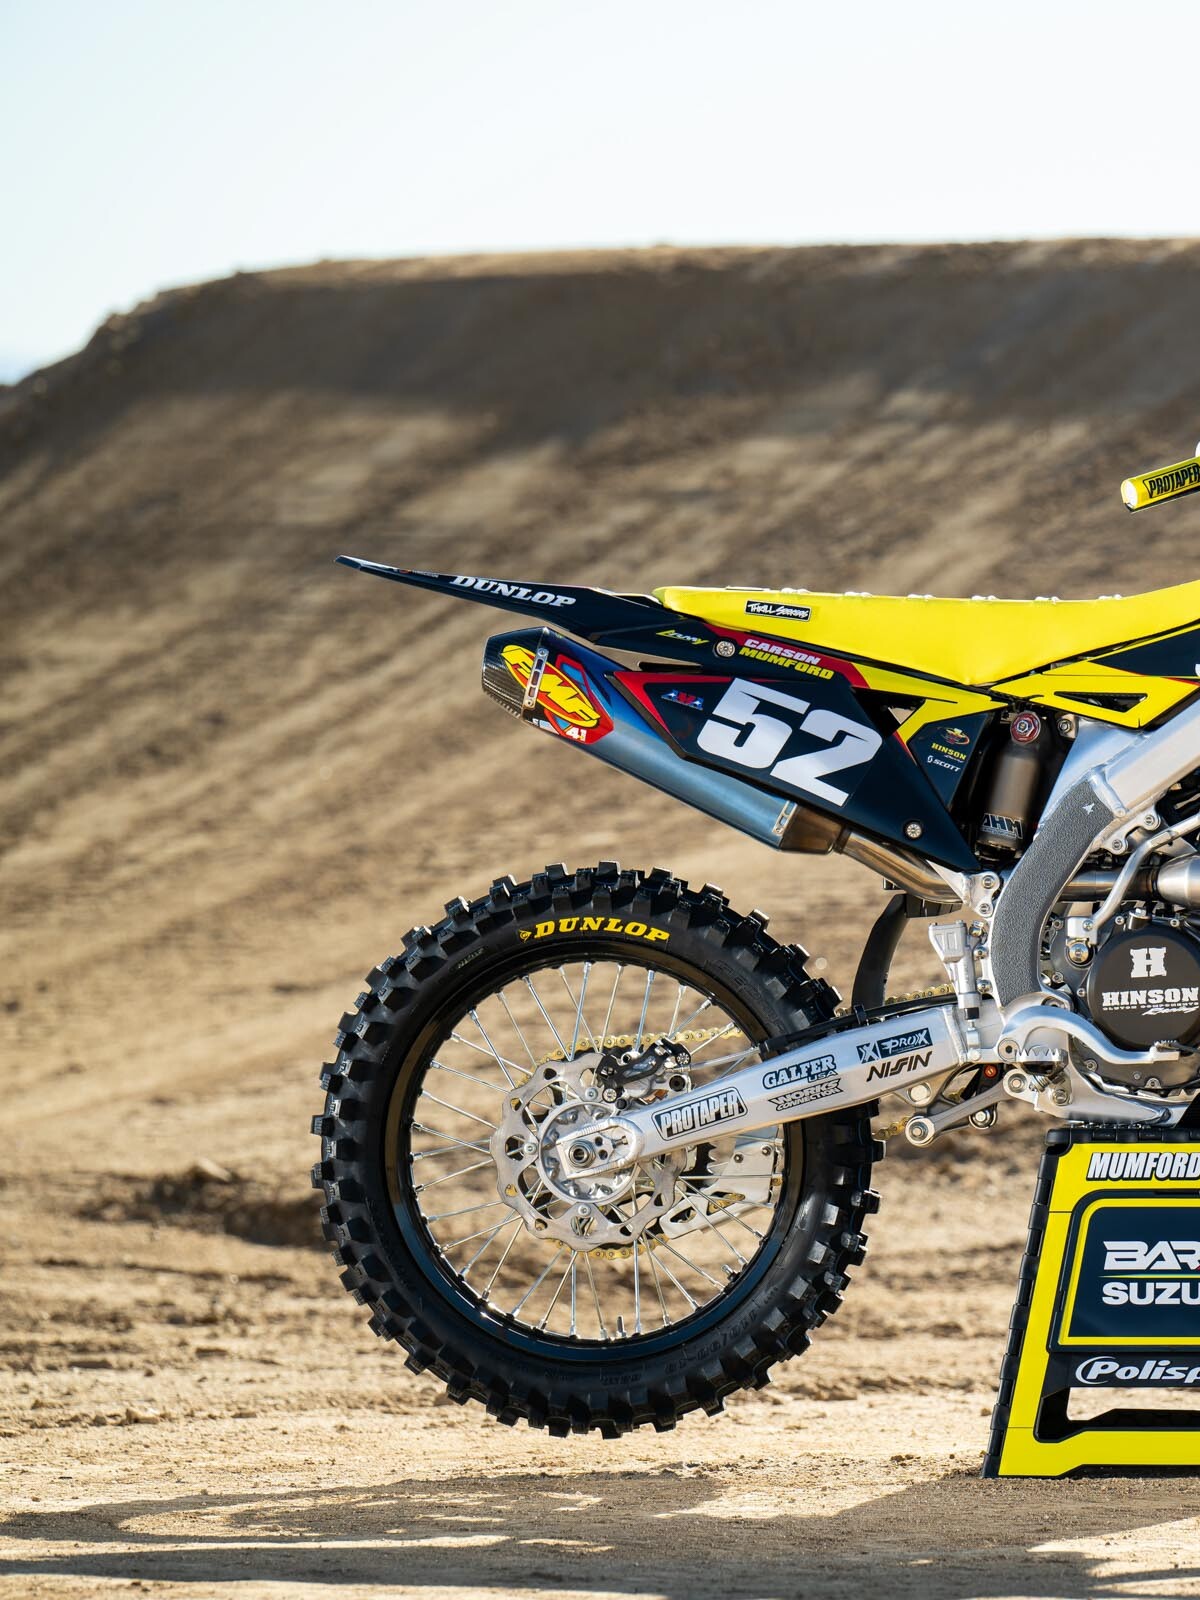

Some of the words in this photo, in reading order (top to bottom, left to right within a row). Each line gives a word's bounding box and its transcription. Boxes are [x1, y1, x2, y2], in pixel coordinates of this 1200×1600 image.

[449, 575, 577, 607] DUNLOP
[739, 647, 835, 680] MUMFORD
[744, 638, 822, 665] CARSON
[698, 678, 883, 807] 52
[931, 742, 967, 761] HINSON
[933, 758, 962, 773] SCOTT
[533, 917, 671, 941] DUNLOP
[1130, 946, 1168, 978] H
[1102, 987, 1199, 1007] HINSON
[763, 1054, 837, 1090] GALFER
[808, 1070, 839, 1083] USA
[769, 1078, 842, 1104] WORKS
[775, 1086, 844, 1112] CONNECTION
[660, 1090, 742, 1138] PROTAPER
